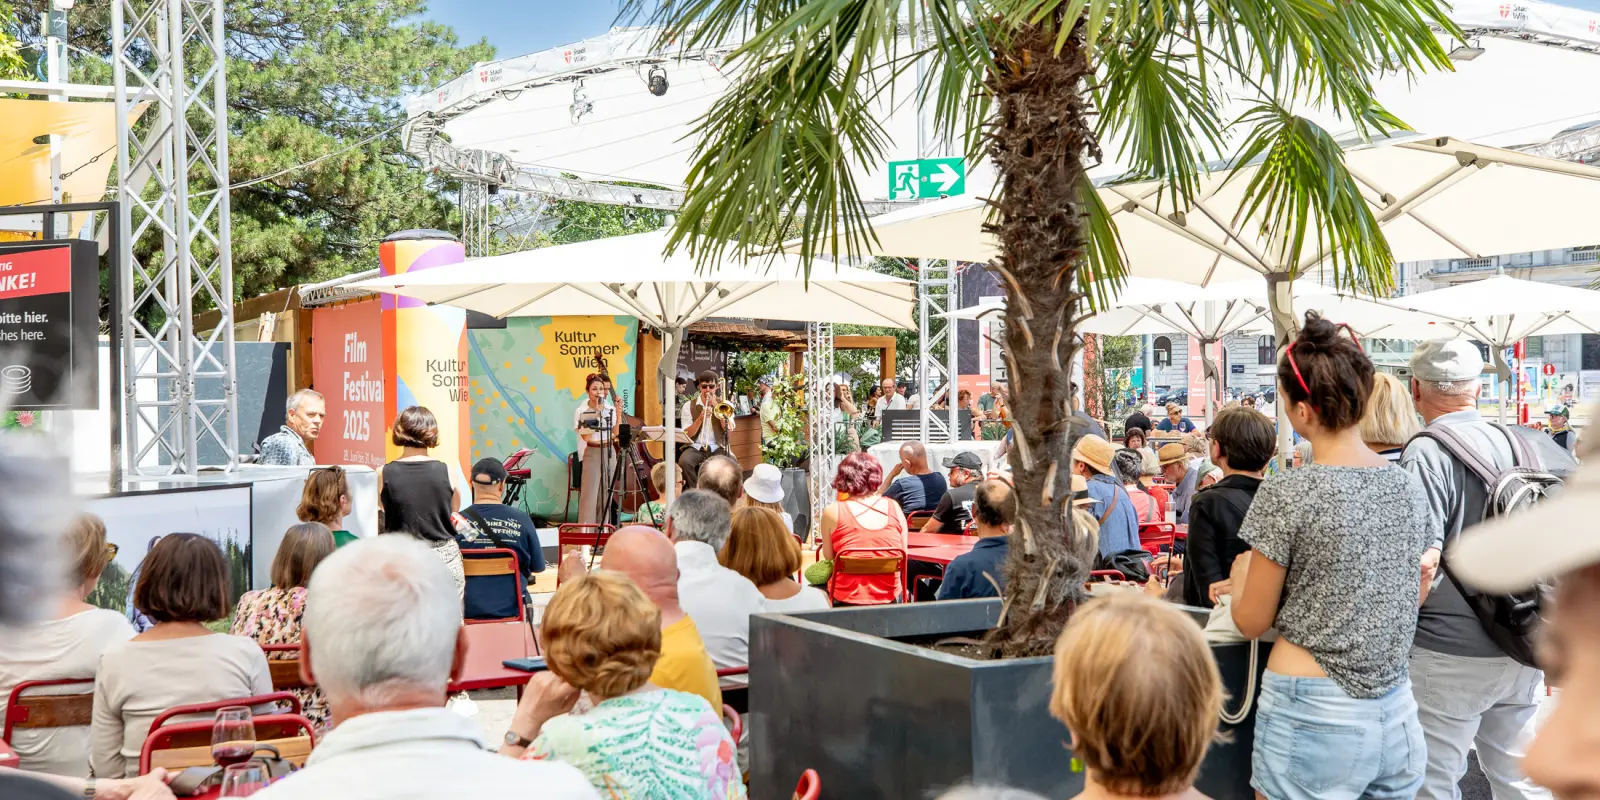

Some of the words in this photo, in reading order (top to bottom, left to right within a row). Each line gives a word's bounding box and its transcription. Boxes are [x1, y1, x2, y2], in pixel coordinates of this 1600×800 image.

[24, 311, 49, 323] hier.
[0, 329, 19, 341] hes
[20, 328, 46, 341] here.
[555, 331, 597, 343] Kultur
[344, 332, 367, 363] Film
[559, 343, 620, 356] Sommer
[426, 359, 466, 372] Kultur
[343, 370, 385, 403] Festival
[343, 410, 370, 441] 2025
